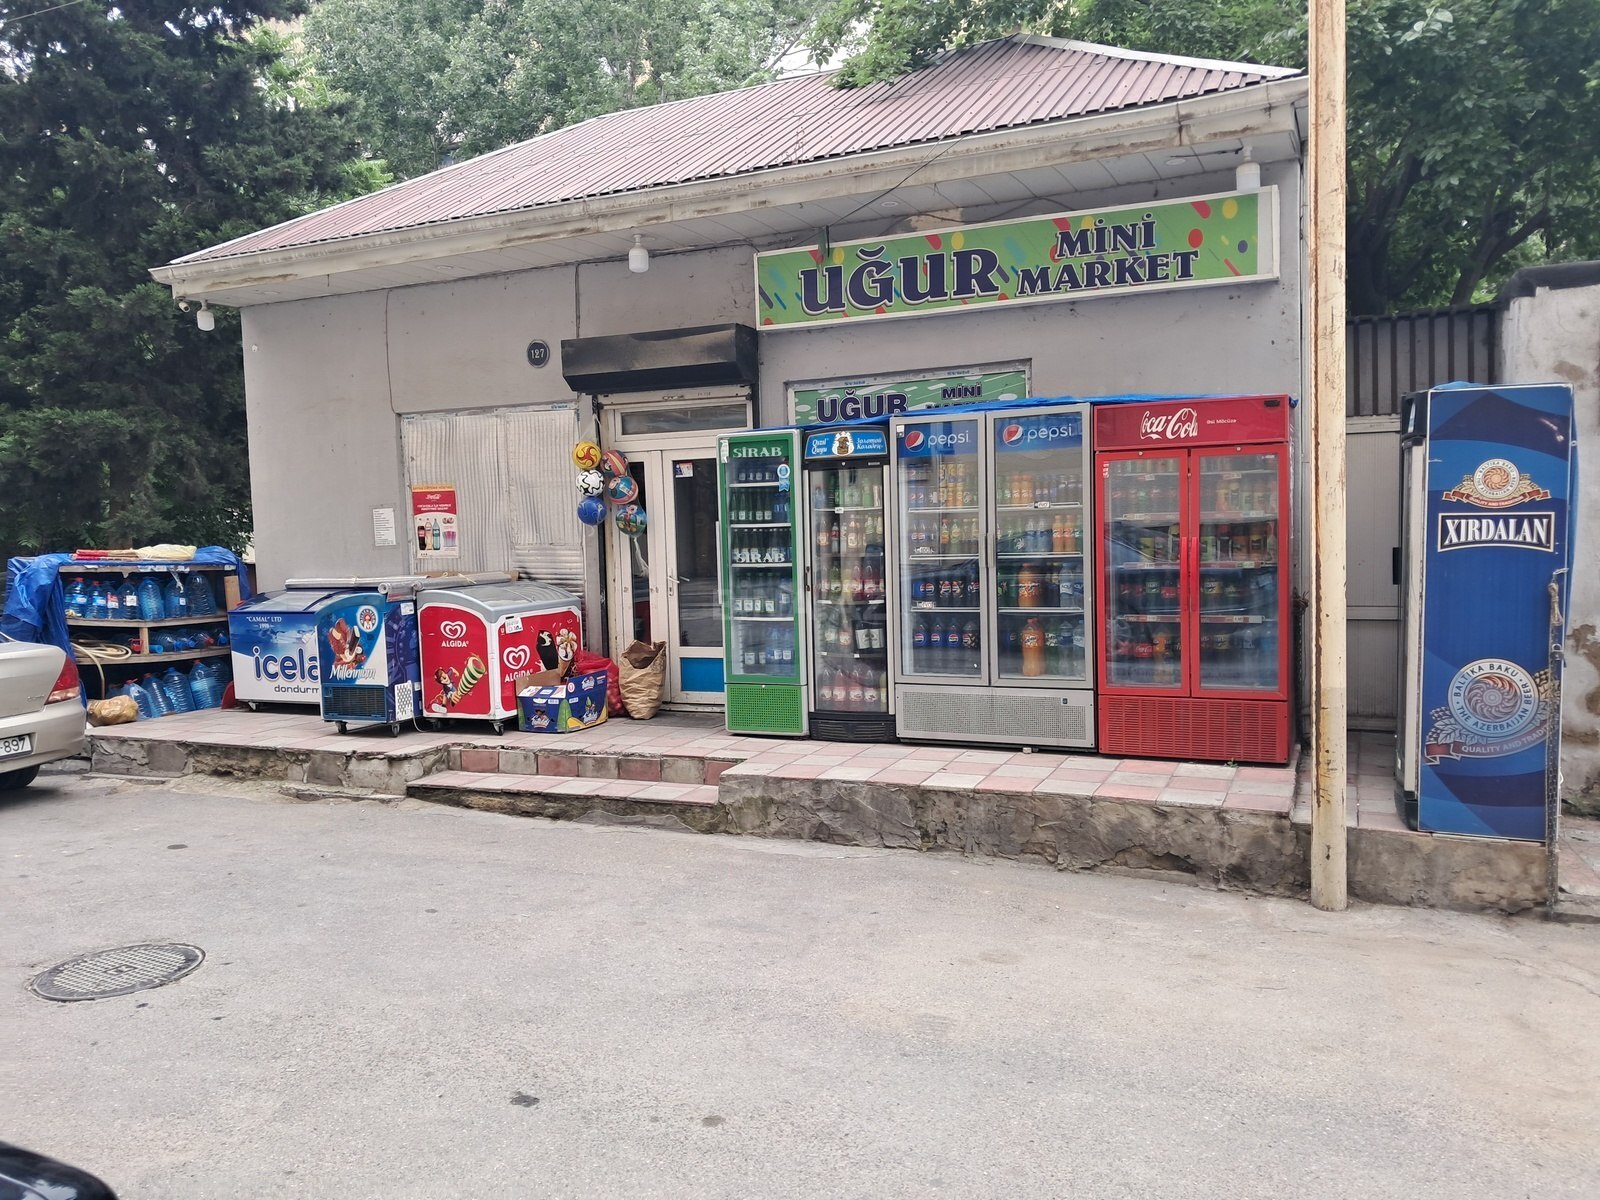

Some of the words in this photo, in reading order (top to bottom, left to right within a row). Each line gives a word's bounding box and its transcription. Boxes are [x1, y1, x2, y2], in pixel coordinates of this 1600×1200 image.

[1055, 212, 1157, 259] MİNİ
[799, 245, 1001, 314] UĞUR
[1018, 250, 1199, 297] MARKET
[530, 349, 545, 359] 127
[942, 383, 982, 400] MİNİ
[817, 389, 909, 423] UĞUR
[927, 430, 970, 449] pepsi
[1027, 423, 1072, 443] pepsi
[1443, 518, 1549, 545] XIRDALAN
[441, 640, 467, 648] ALGIDA
[329, 664, 376, 680] Millennium
[1454, 664, 1485, 697] BALTIKA
[1489, 663, 1519, 678] BAKU
[1456, 705, 1472, 722] THE
[1472, 708, 1529, 731] AZERBAIJAN
[1521, 682, 1533, 705] BEER
[1461, 743, 1501, 753] QUALITY
[1503, 741, 1522, 751] AND
